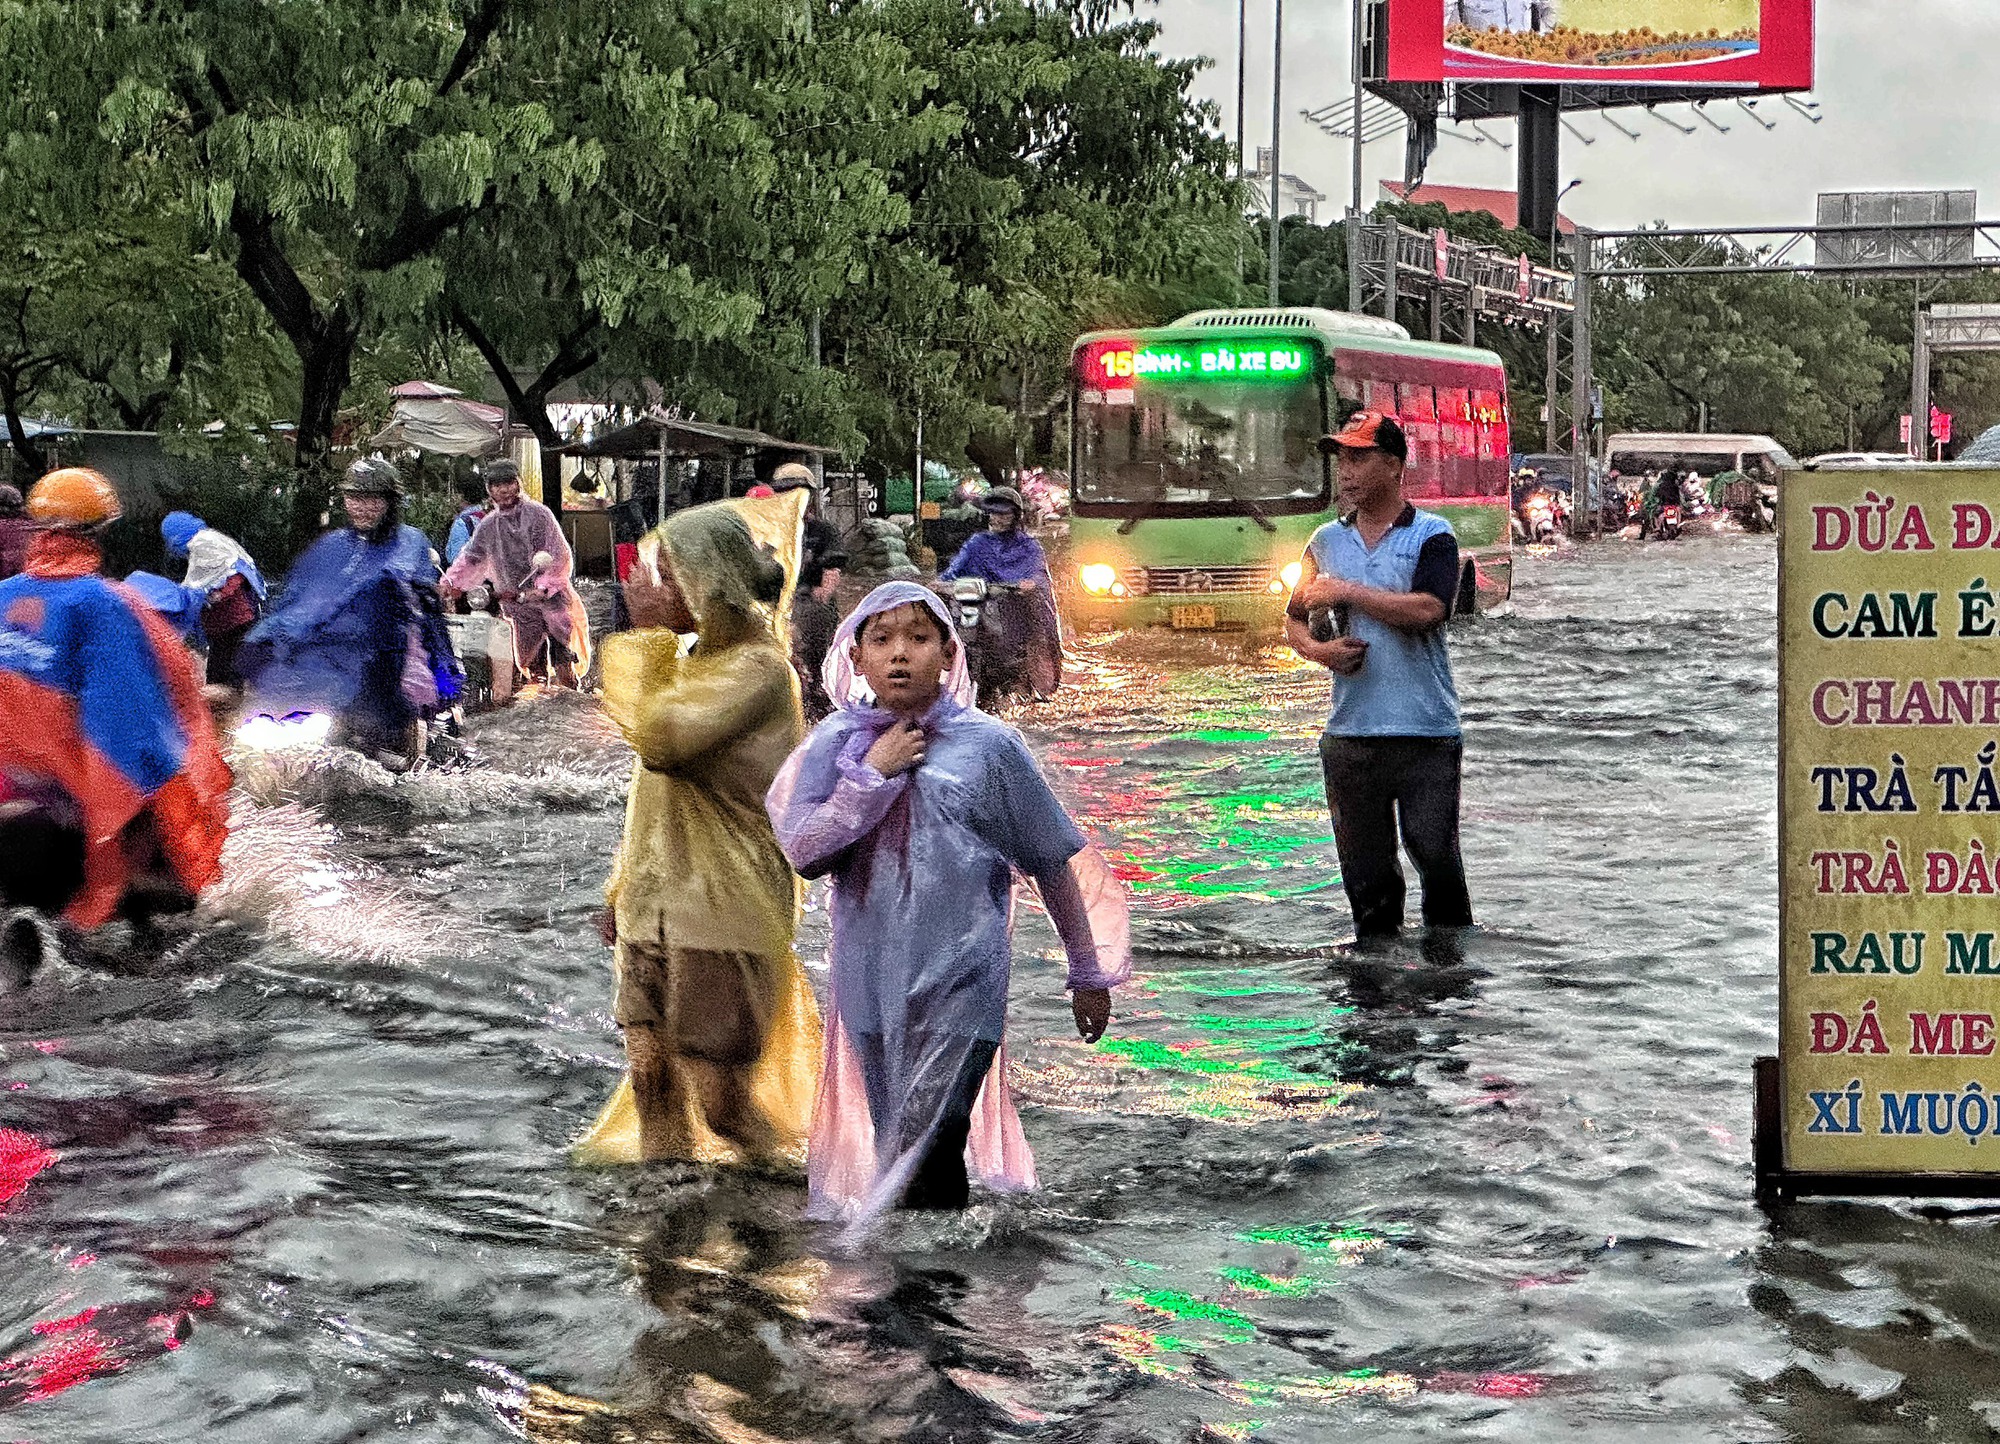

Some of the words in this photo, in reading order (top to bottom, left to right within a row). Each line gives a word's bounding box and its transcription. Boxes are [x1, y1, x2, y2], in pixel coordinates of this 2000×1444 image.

[1100, 351, 1132, 377] 15
[1239, 352, 1266, 371] XE
[1812, 491, 1935, 551] DỪA
[1952, 504, 2000, 549] Đ
[1812, 592, 1938, 638] CAM
[1958, 577, 2000, 637] É
[1811, 753, 1917, 812] TRÀ
[1811, 839, 1909, 894] TRÀ
[1925, 839, 2000, 894] ĐÀ
[1810, 933, 1926, 974] RAU
[1945, 933, 2000, 975] M
[1810, 1000, 1890, 1054] ĐÁ
[1909, 1013, 1996, 1055] ME
[1808, 1079, 1863, 1133] XÍ
